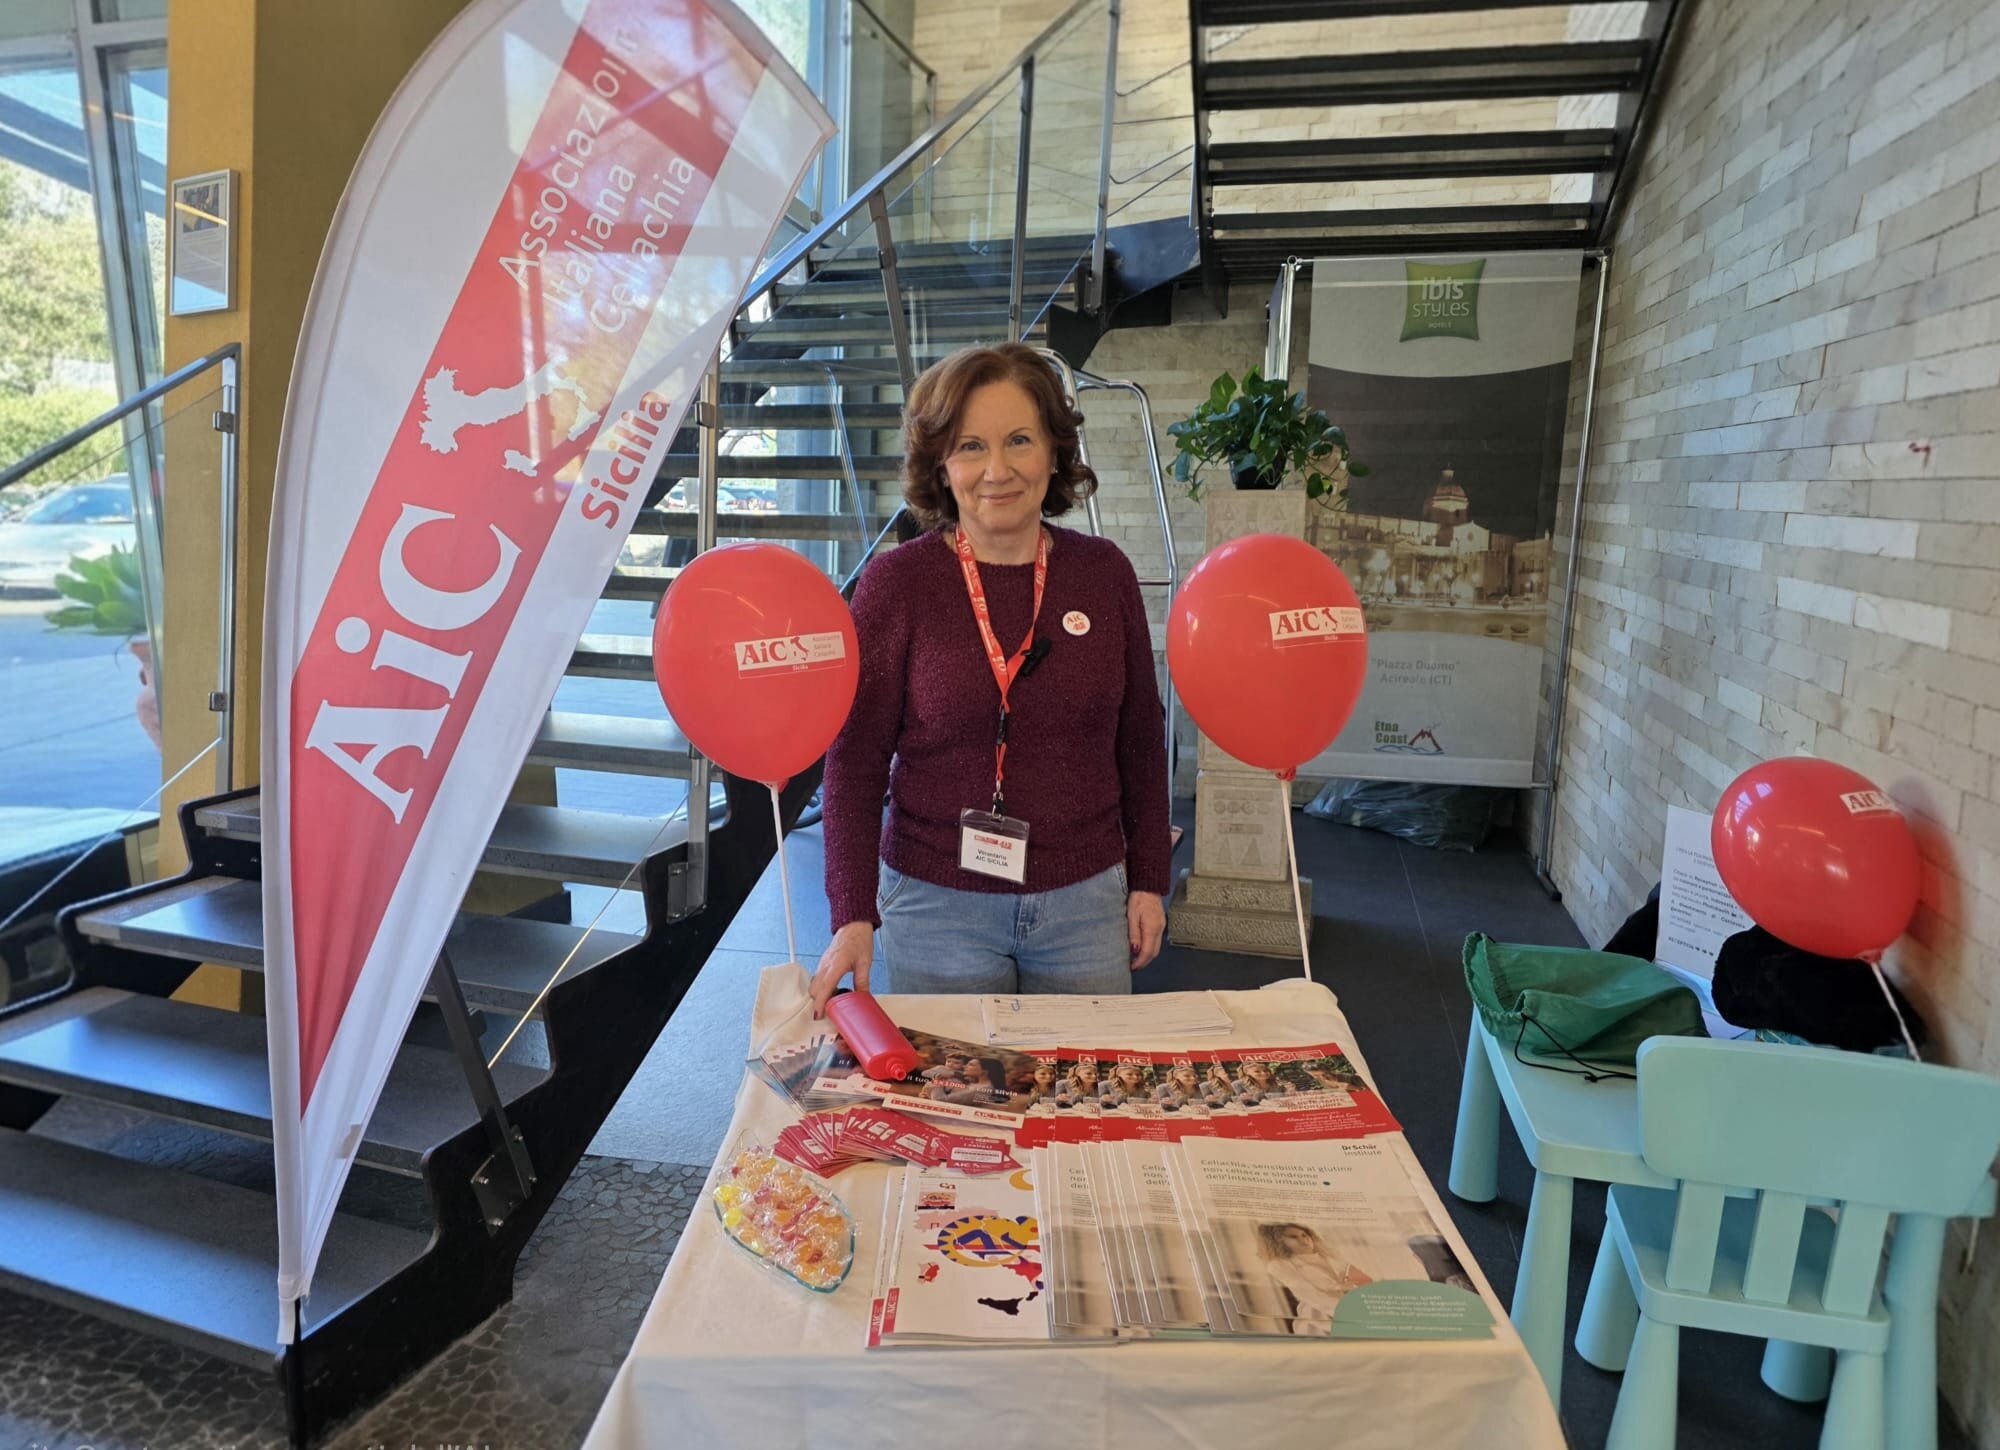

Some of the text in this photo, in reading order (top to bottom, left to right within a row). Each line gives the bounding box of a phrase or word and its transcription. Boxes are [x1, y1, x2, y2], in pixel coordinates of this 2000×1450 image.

[544, 162, 637, 309] Italiana
[590, 155, 695, 334] Celiachia
[1422, 277, 1464, 300] ibis
[581, 391, 671, 529] Sicilia
[1277, 610, 1320, 634] AiC
[305, 502, 522, 824] AiC
[742, 640, 787, 665] AiC
[1375, 721, 1399, 732] Etna
[1376, 733, 1408, 744] Coast
[1271, 1171, 1318, 1179] sindrome
